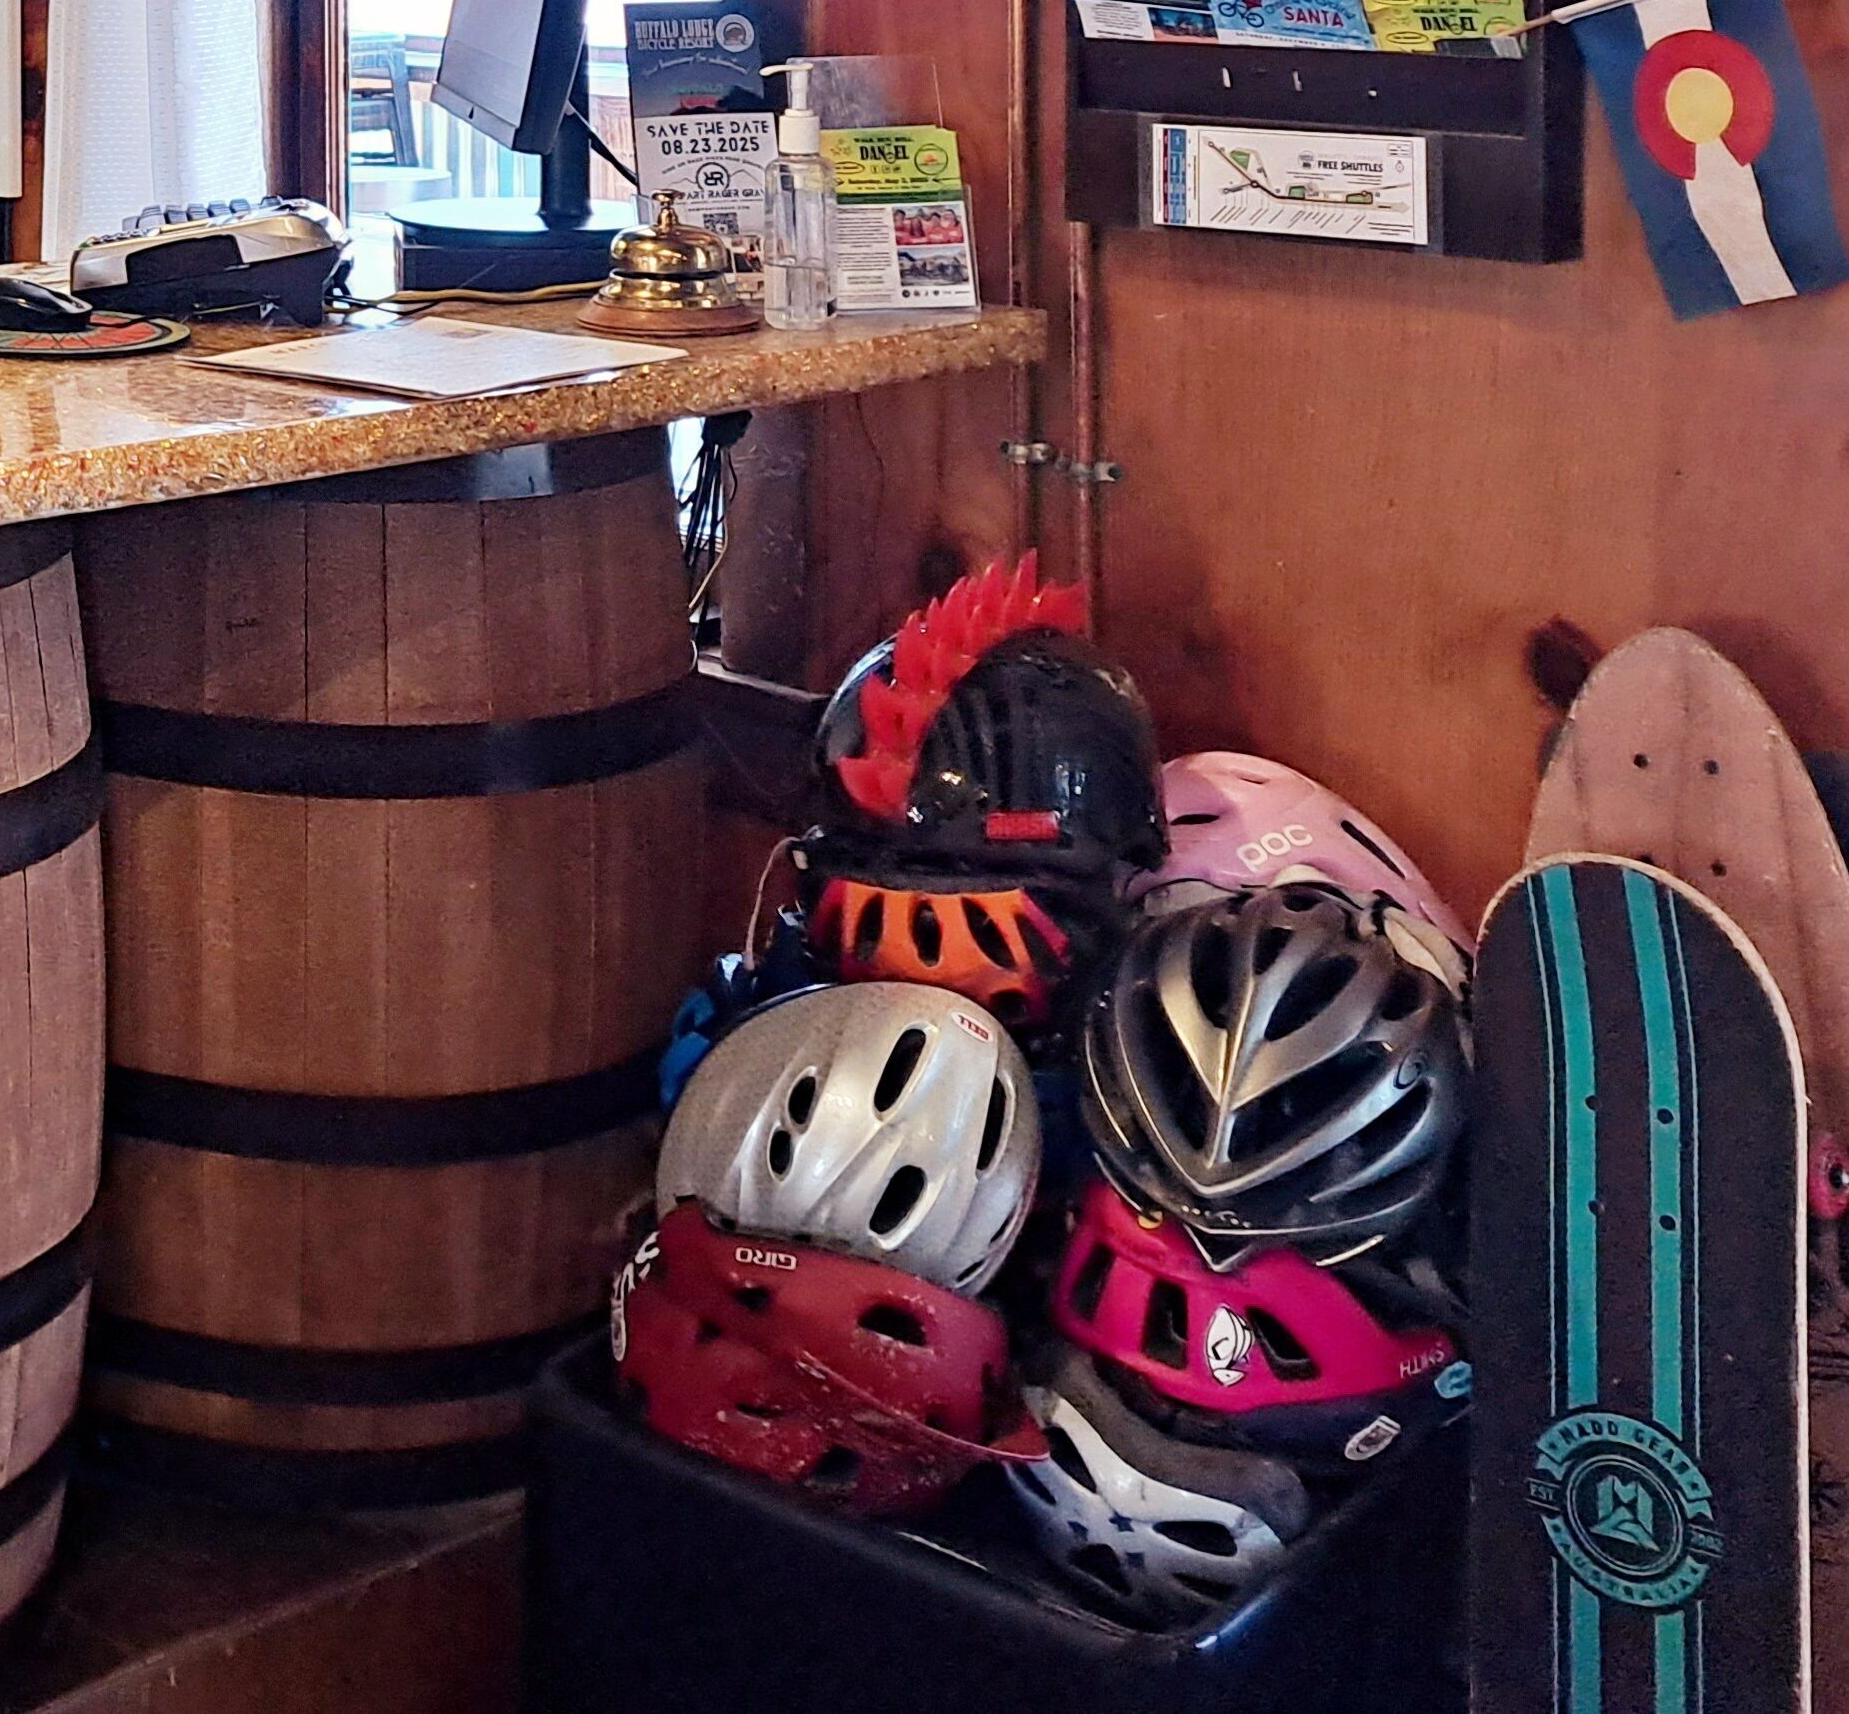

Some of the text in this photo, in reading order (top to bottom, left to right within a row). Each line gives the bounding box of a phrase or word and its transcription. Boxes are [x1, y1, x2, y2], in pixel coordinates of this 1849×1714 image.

[1282, 6, 1345, 29] SANTA
[647, 119, 771, 138] SAVE THE DATE
[661, 136, 761, 156] 08.23.2025
[1317, 160, 1384, 172] FREE SHUTTLES
[708, 189, 740, 199] RAGER
[734, 1246, 799, 1272] GIRO
[1562, 1420, 1691, 1476] MADD GEAR
